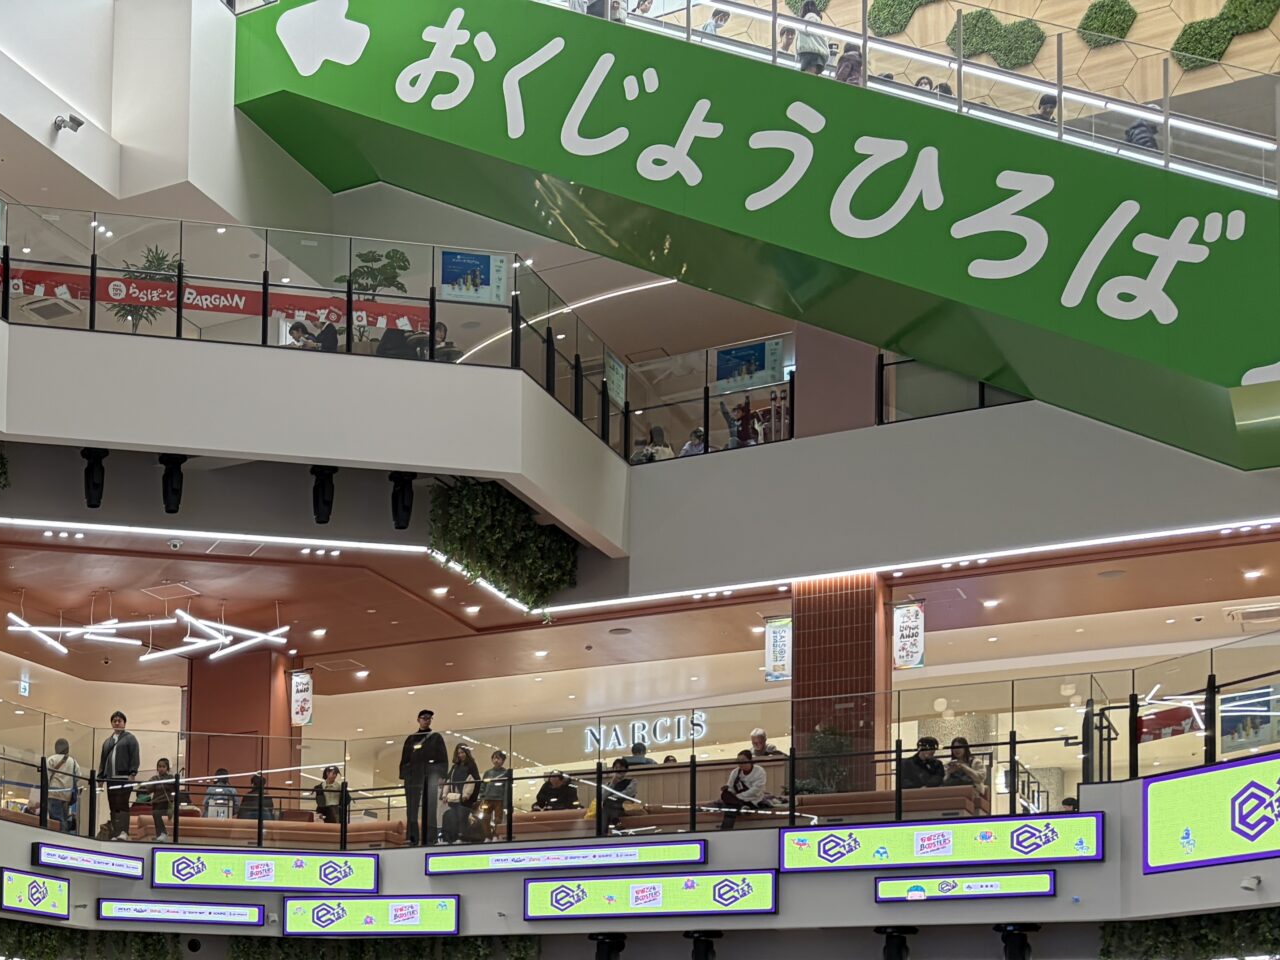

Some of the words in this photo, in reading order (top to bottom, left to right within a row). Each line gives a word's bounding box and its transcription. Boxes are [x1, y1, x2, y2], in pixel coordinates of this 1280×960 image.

[395, 7, 1246, 325] おくじょうひろば
[129, 283, 176, 302] ららぽーと
[183, 288, 246, 309] BARGAIN
[585, 712, 708, 752] NARCIS
